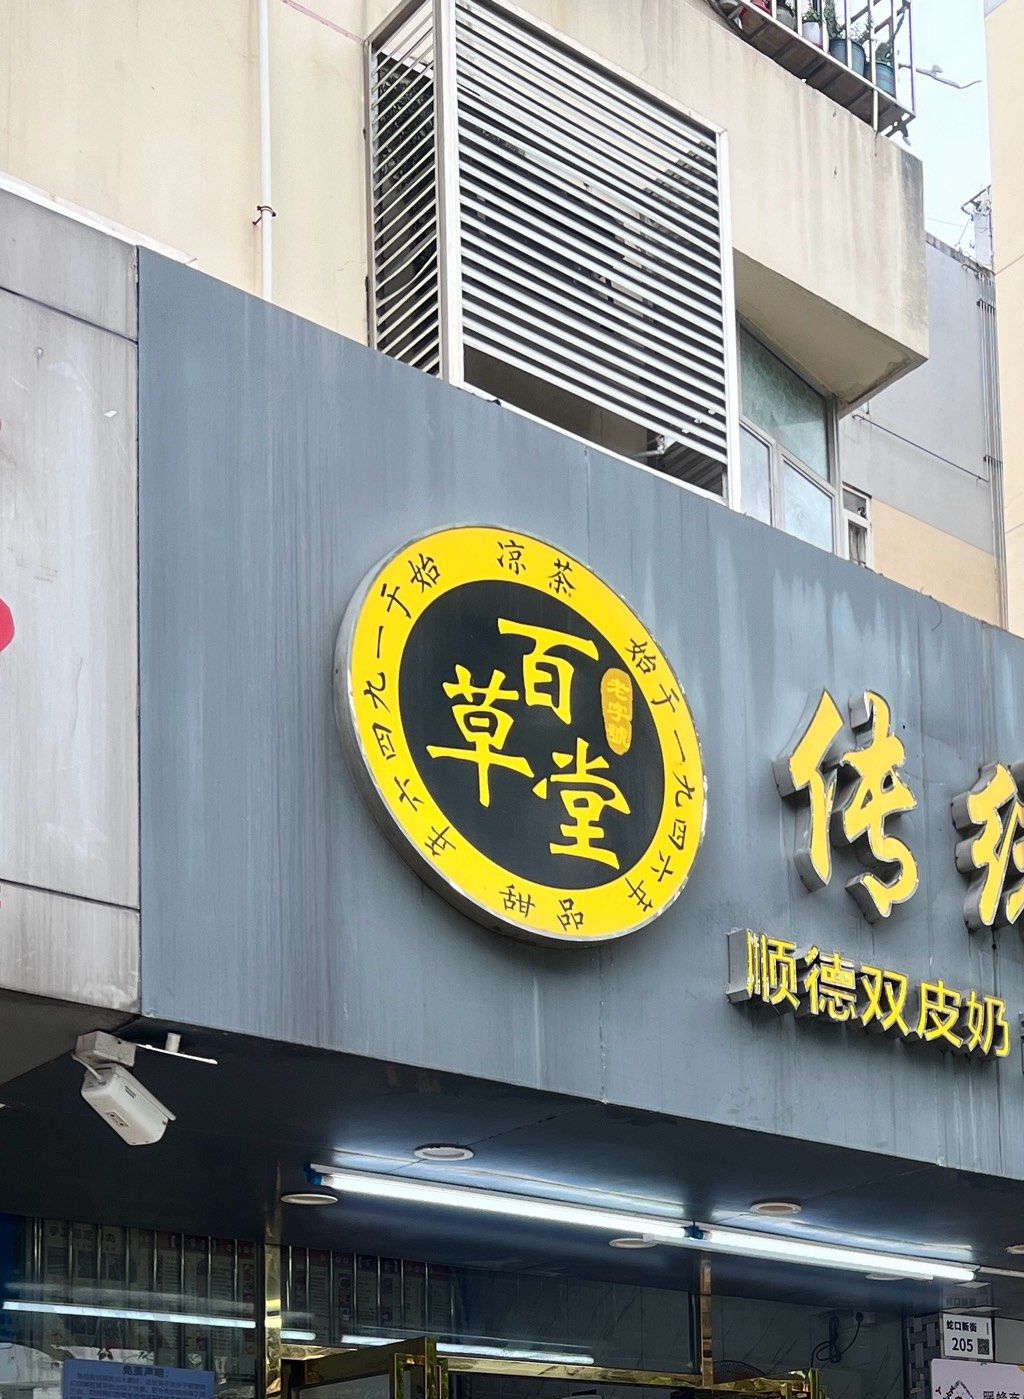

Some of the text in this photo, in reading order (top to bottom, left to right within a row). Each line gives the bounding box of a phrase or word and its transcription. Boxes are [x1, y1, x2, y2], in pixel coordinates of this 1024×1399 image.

[496, 539, 576, 597] 凉茶
[362, 552, 441, 858] 始于一九四六年
[426, 617, 631, 870] 百草堂
[623, 637, 696, 912] 始于一九四六年
[498, 883, 585, 931] 甜品
[740, 928, 1010, 1059] 顺德双皮奶
[946, 1320, 977, 1333] 蛇口新街
[951, 1337, 974, 1352] 205
